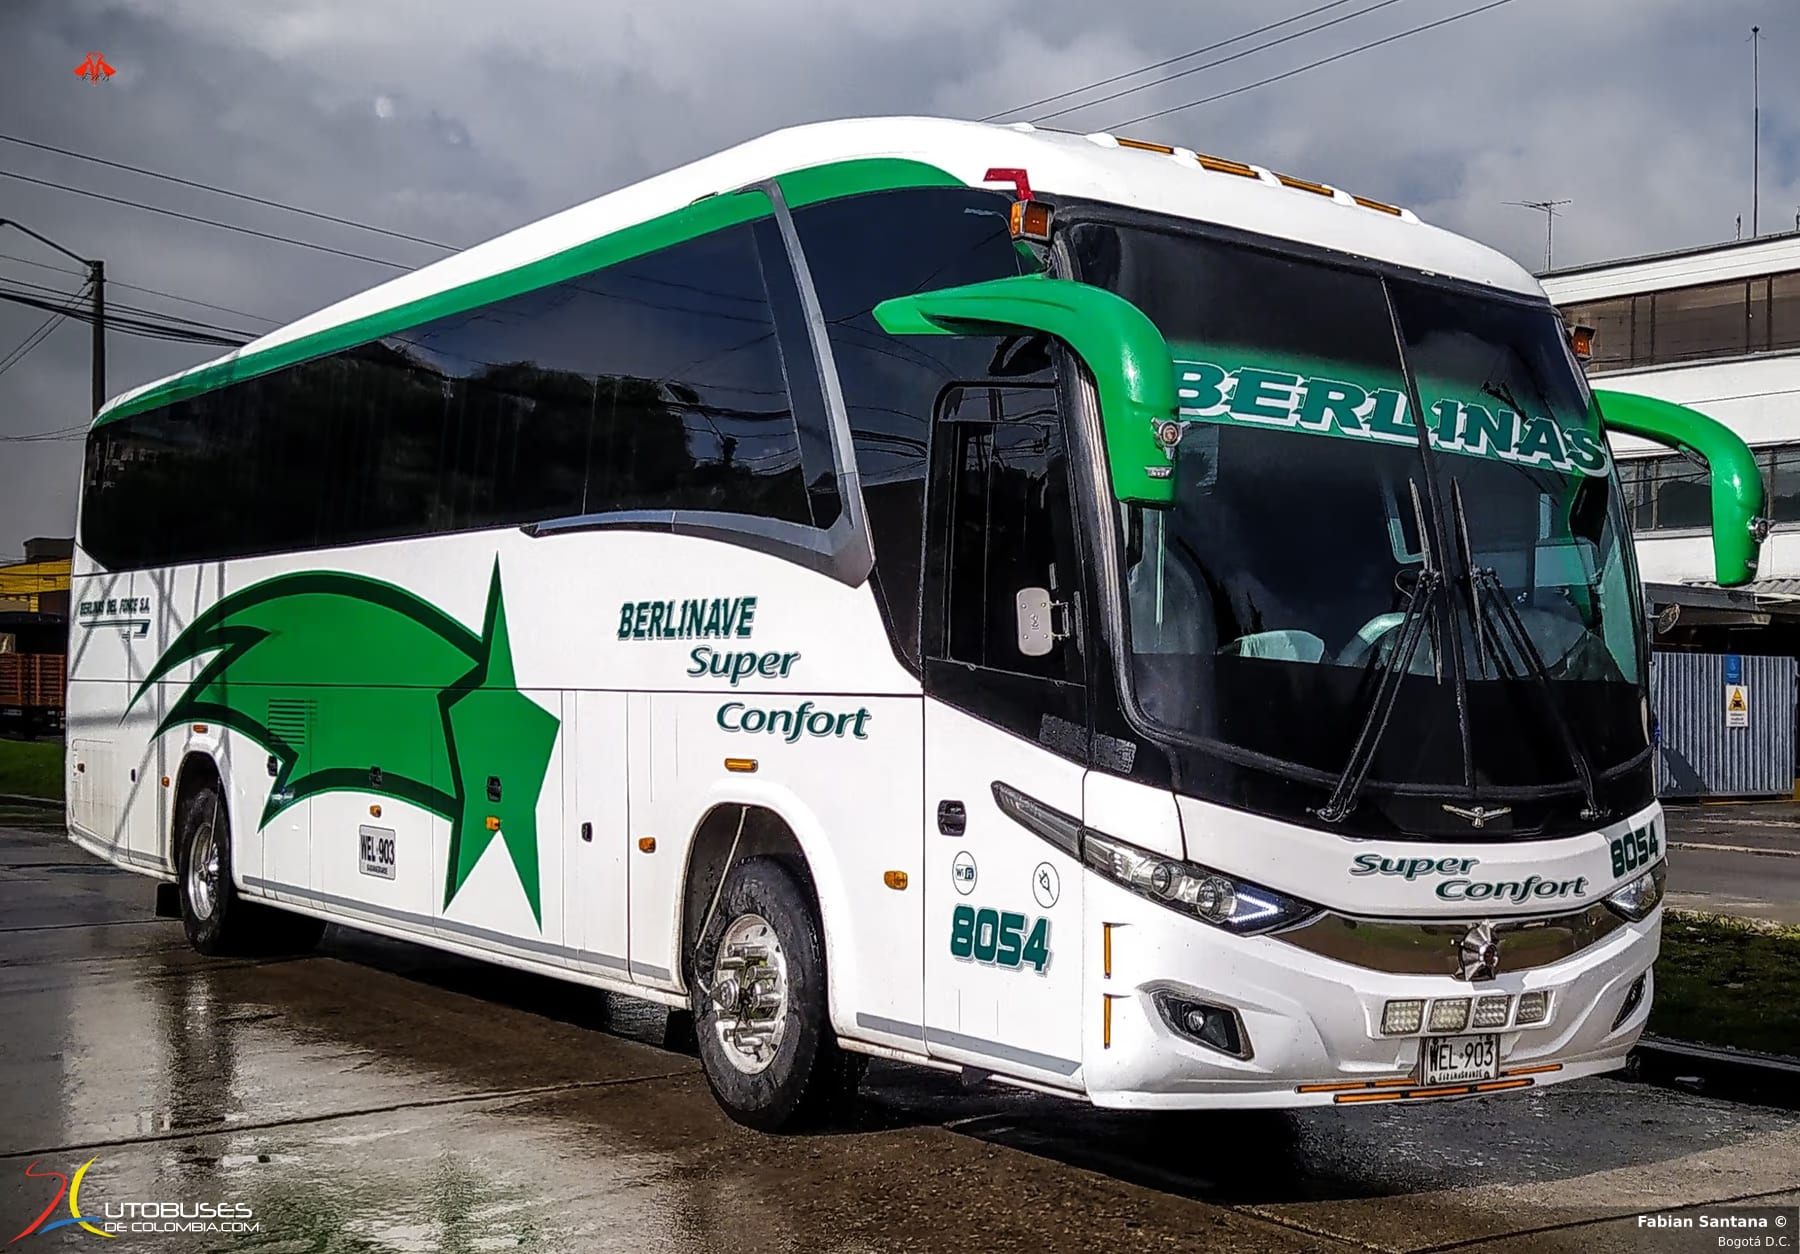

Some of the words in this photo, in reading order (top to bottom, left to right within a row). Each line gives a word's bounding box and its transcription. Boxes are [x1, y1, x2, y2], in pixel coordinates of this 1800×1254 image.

[1174, 360, 1610, 477] BERLINAS
[617, 597, 757, 640] BERLINAVE
[687, 644, 801, 687] Super
[716, 701, 872, 744] Confort
[1350, 853, 1480, 880] Super
[1610, 820, 1659, 879] 8054
[1434, 876, 1589, 905] Confort
[950, 904, 1053, 977] 8054
